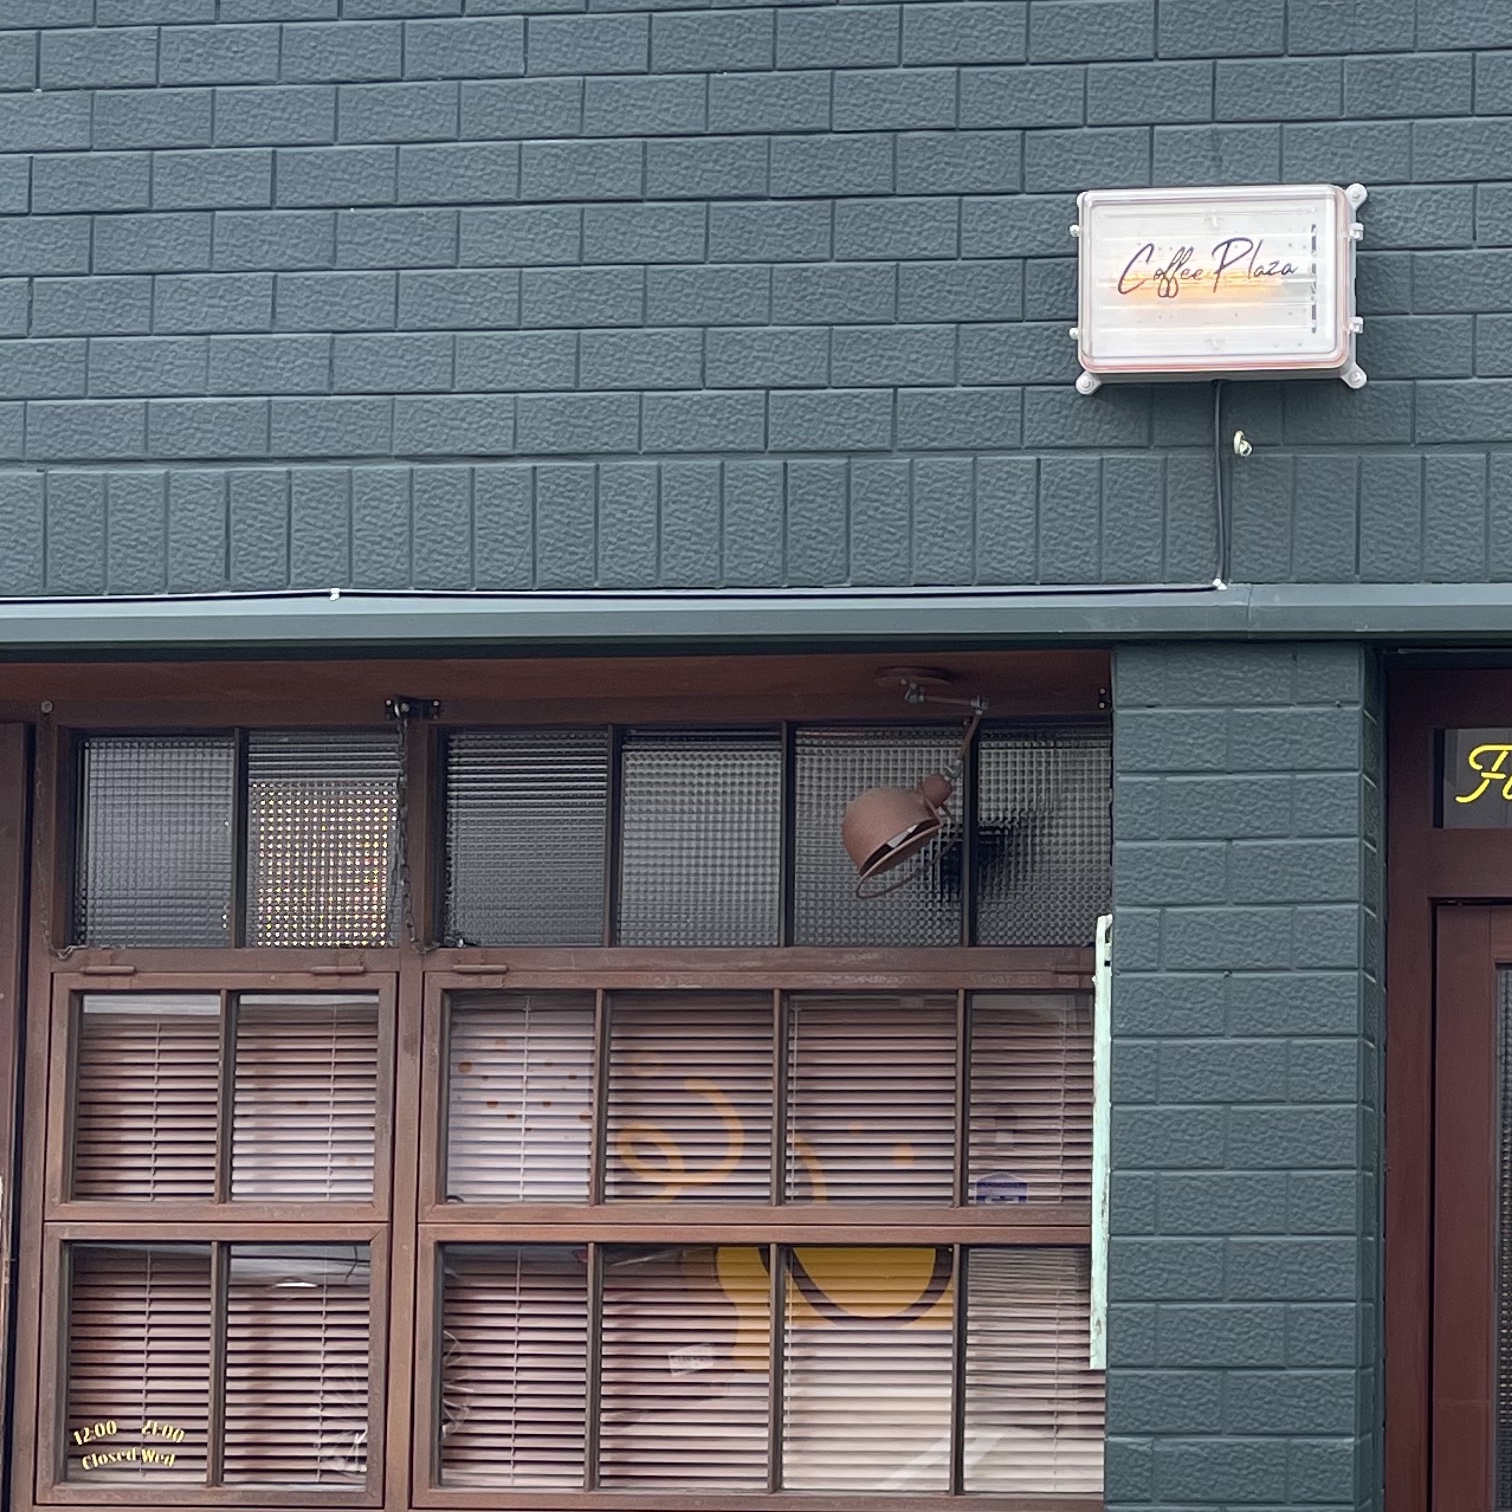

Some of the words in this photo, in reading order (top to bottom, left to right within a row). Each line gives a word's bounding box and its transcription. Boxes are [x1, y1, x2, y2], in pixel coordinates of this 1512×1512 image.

[1117, 242, 1206, 298] Coffee
[1211, 236, 1299, 293] Plaza
[73, 1420, 118, 1446] 12:00
[81, 1446, 137, 1471] Closed
[141, 1448, 176, 1468] Wed
